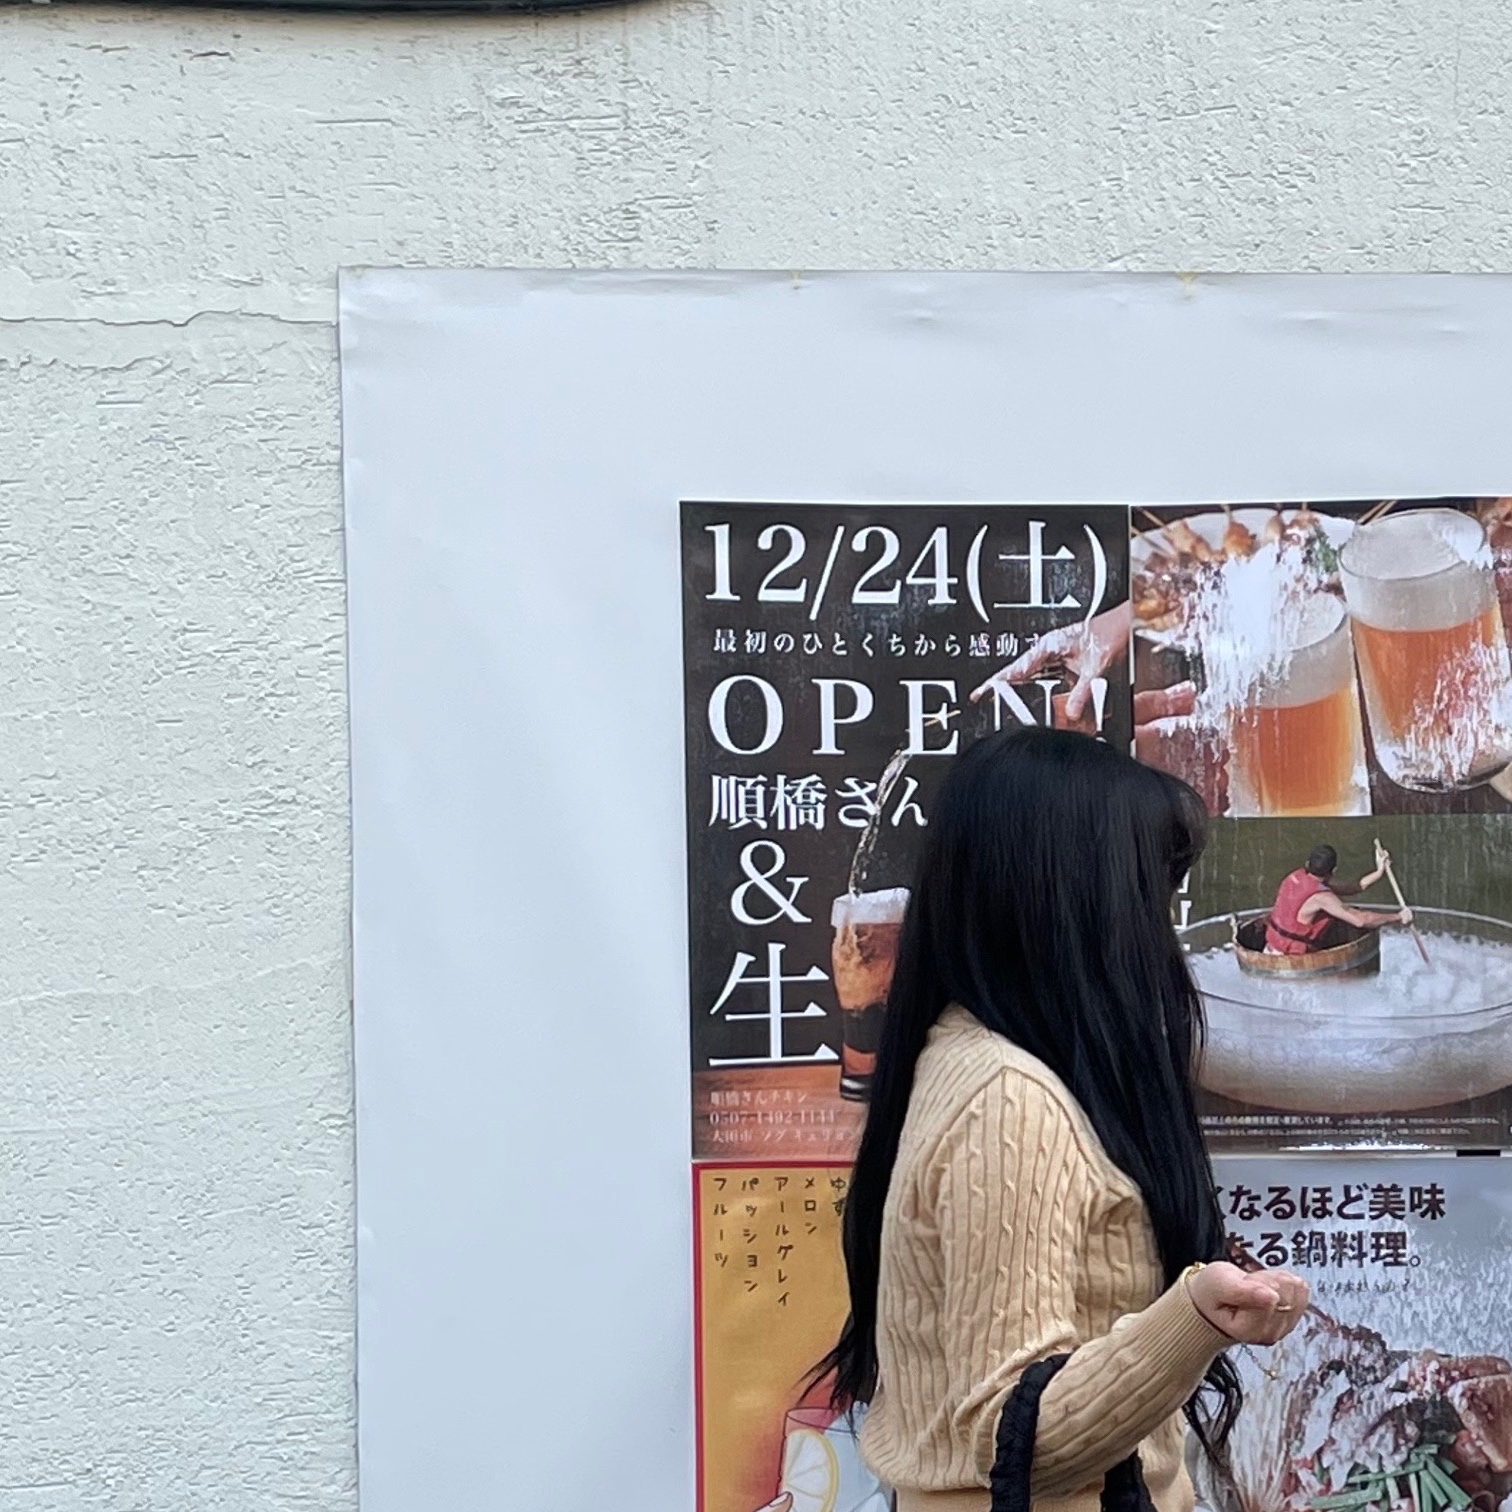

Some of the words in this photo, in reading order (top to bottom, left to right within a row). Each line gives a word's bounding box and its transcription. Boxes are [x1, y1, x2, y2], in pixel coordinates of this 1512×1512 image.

[704, 520, 1109, 623] 12/24(土)
[708, 773, 928, 830] 順橋さん
[730, 839, 813, 926] &
[708, 941, 839, 1067] 生
[712, 1177, 728, 1268] フルーツ
[804, 1176, 817, 1235] メロン
